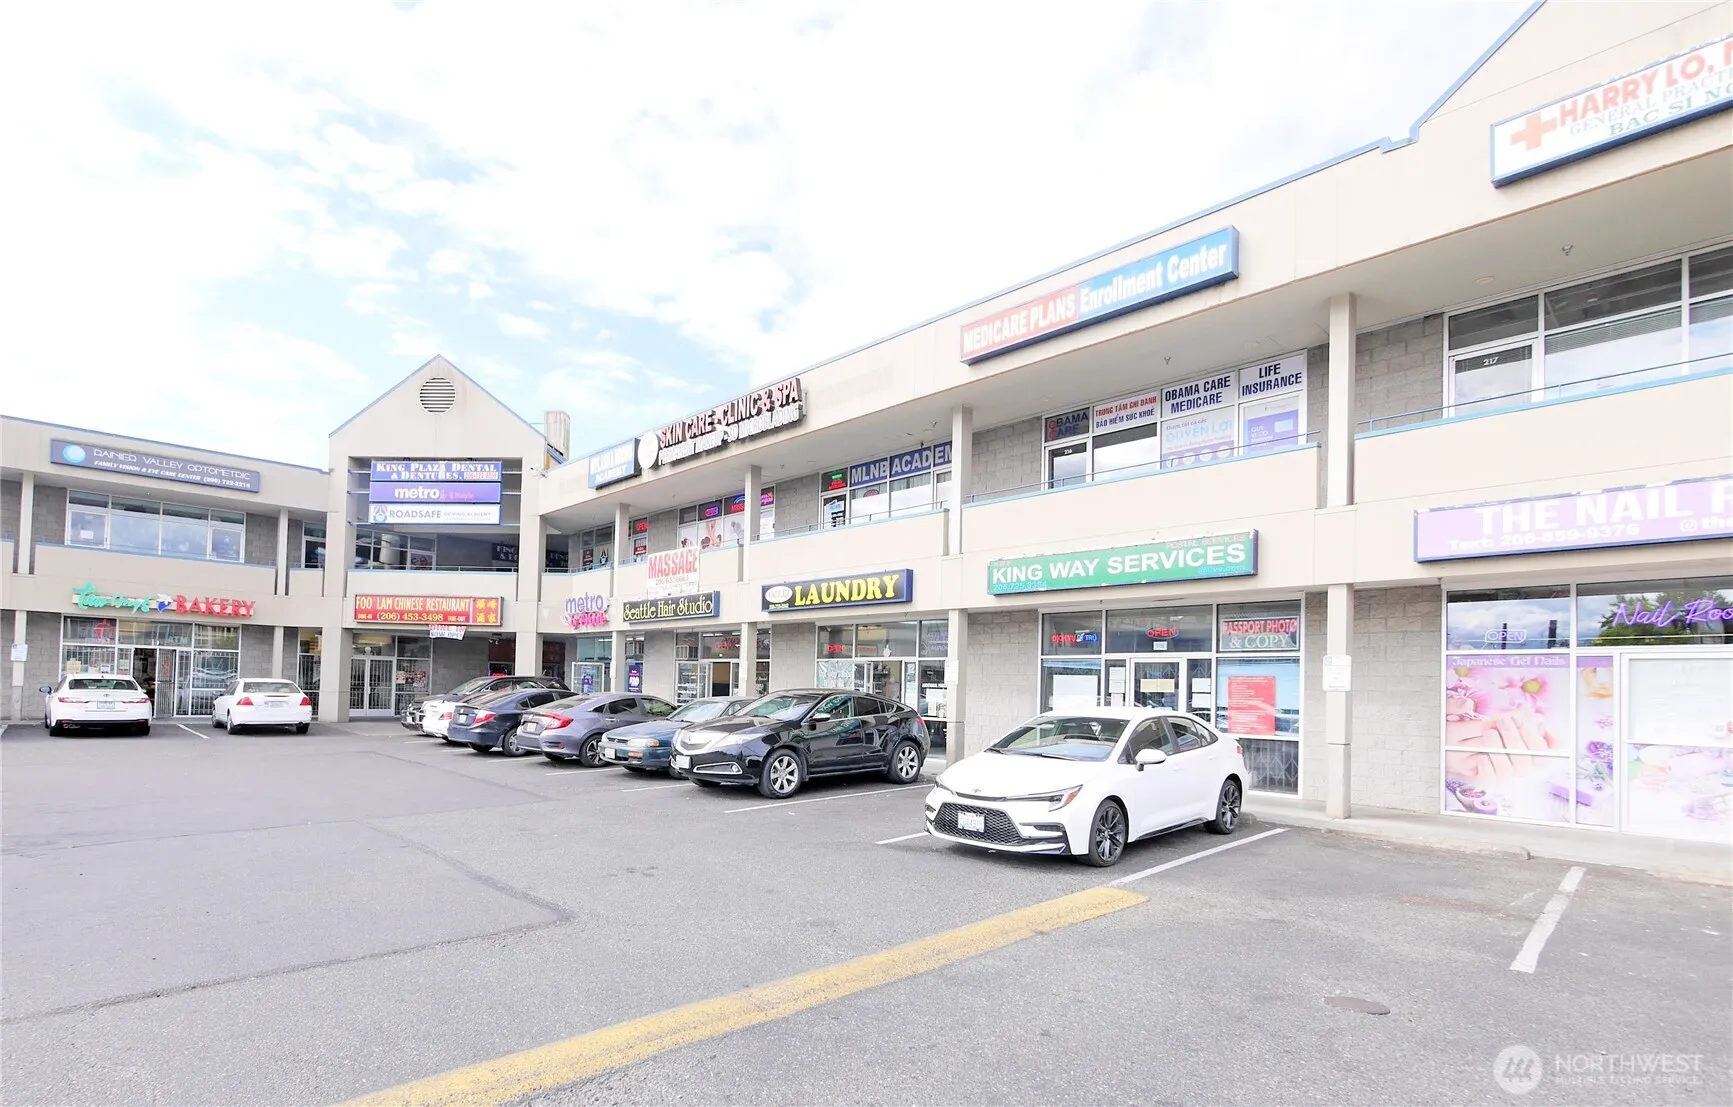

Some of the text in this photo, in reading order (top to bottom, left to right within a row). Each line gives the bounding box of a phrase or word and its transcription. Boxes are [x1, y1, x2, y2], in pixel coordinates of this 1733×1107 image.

[1559, 54, 1715, 127] HARRY LO,
[1570, 97, 1656, 137] GENERAL
[963, 243, 1228, 354] MEDICARE PLANS Enrollment Center
[1258, 363, 1281, 379] LIFE
[1483, 356, 1499, 366] 217
[1165, 375, 1231, 401] OBAMA CARE
[1242, 372, 1302, 396] INSURANCE
[658, 425, 684, 449] SKIN
[685, 413, 714, 441] CARE
[721, 394, 762, 426] CLINIC
[774, 377, 801, 407] SPA
[1171, 392, 1222, 414] MEDICARE
[94, 448, 251, 480] RAINIER VALLEY OPTOMETRIC
[94, 460, 119, 470] FAMILY
[119, 464, 141, 473] VISION
[148, 467, 160, 475] EYE
[160, 469, 177, 478] CARE
[177, 471, 201, 481] CENTER
[452, 463, 497, 472] DENTAL
[851, 461, 888, 483] MLNB
[394, 486, 440, 499] metro
[389, 510, 441, 519] ROADSAFE
[1476, 500, 1563, 536] THE
[1576, 487, 1693, 527] NAIL
[1500, 523, 1640, 548] 206-859-9376
[648, 550, 698, 579] MASSAGE
[993, 543, 1246, 584] KING WAY SERVICES
[795, 574, 900, 606] LAUNDRY
[175, 594, 256, 618] BAKERY
[356, 596, 470, 612] FOO LAM CHINESE RESTAURANT
[565, 592, 604, 613] metro
[624, 594, 713, 620] Seattle Hair Studio
[377, 611, 400, 621] (206)
[402, 612, 444, 622] 453-3498
[1613, 601, 1676, 628] Nail
[1146, 628, 1176, 638] OPEN
[1222, 619, 1297, 634] PASSPORT PHOTO
[1487, 631, 1524, 641] OPEN
[1229, 634, 1289, 648] & COPY
[1452, 656, 1505, 667] Japanese
[1510, 656, 1531, 666] Gel
